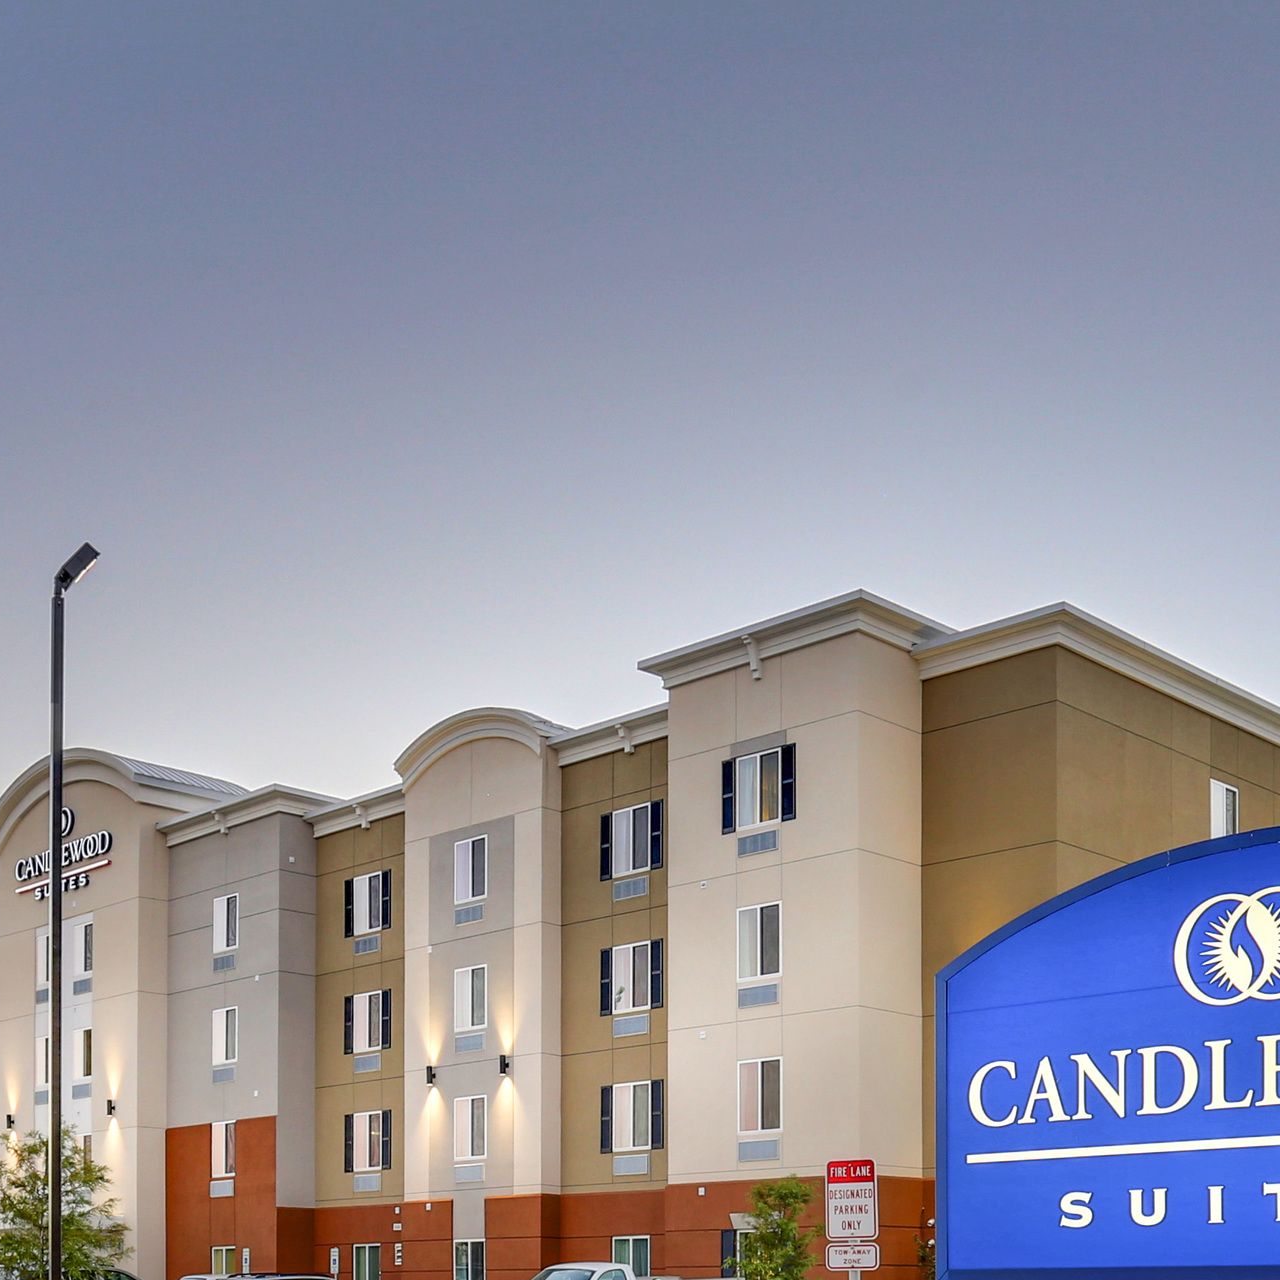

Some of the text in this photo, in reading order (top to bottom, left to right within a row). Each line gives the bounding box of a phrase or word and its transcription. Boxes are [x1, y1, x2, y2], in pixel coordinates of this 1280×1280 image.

[15, 830, 110, 881] CANEWOOD
[34, 873, 88, 900] SUTES
[830, 1165, 872, 1178] FIRE LANE
[829, 1188, 873, 1200] DESIGNATED
[834, 1204, 869, 1215] PARKING
[841, 1220, 862, 1231] ONLY
